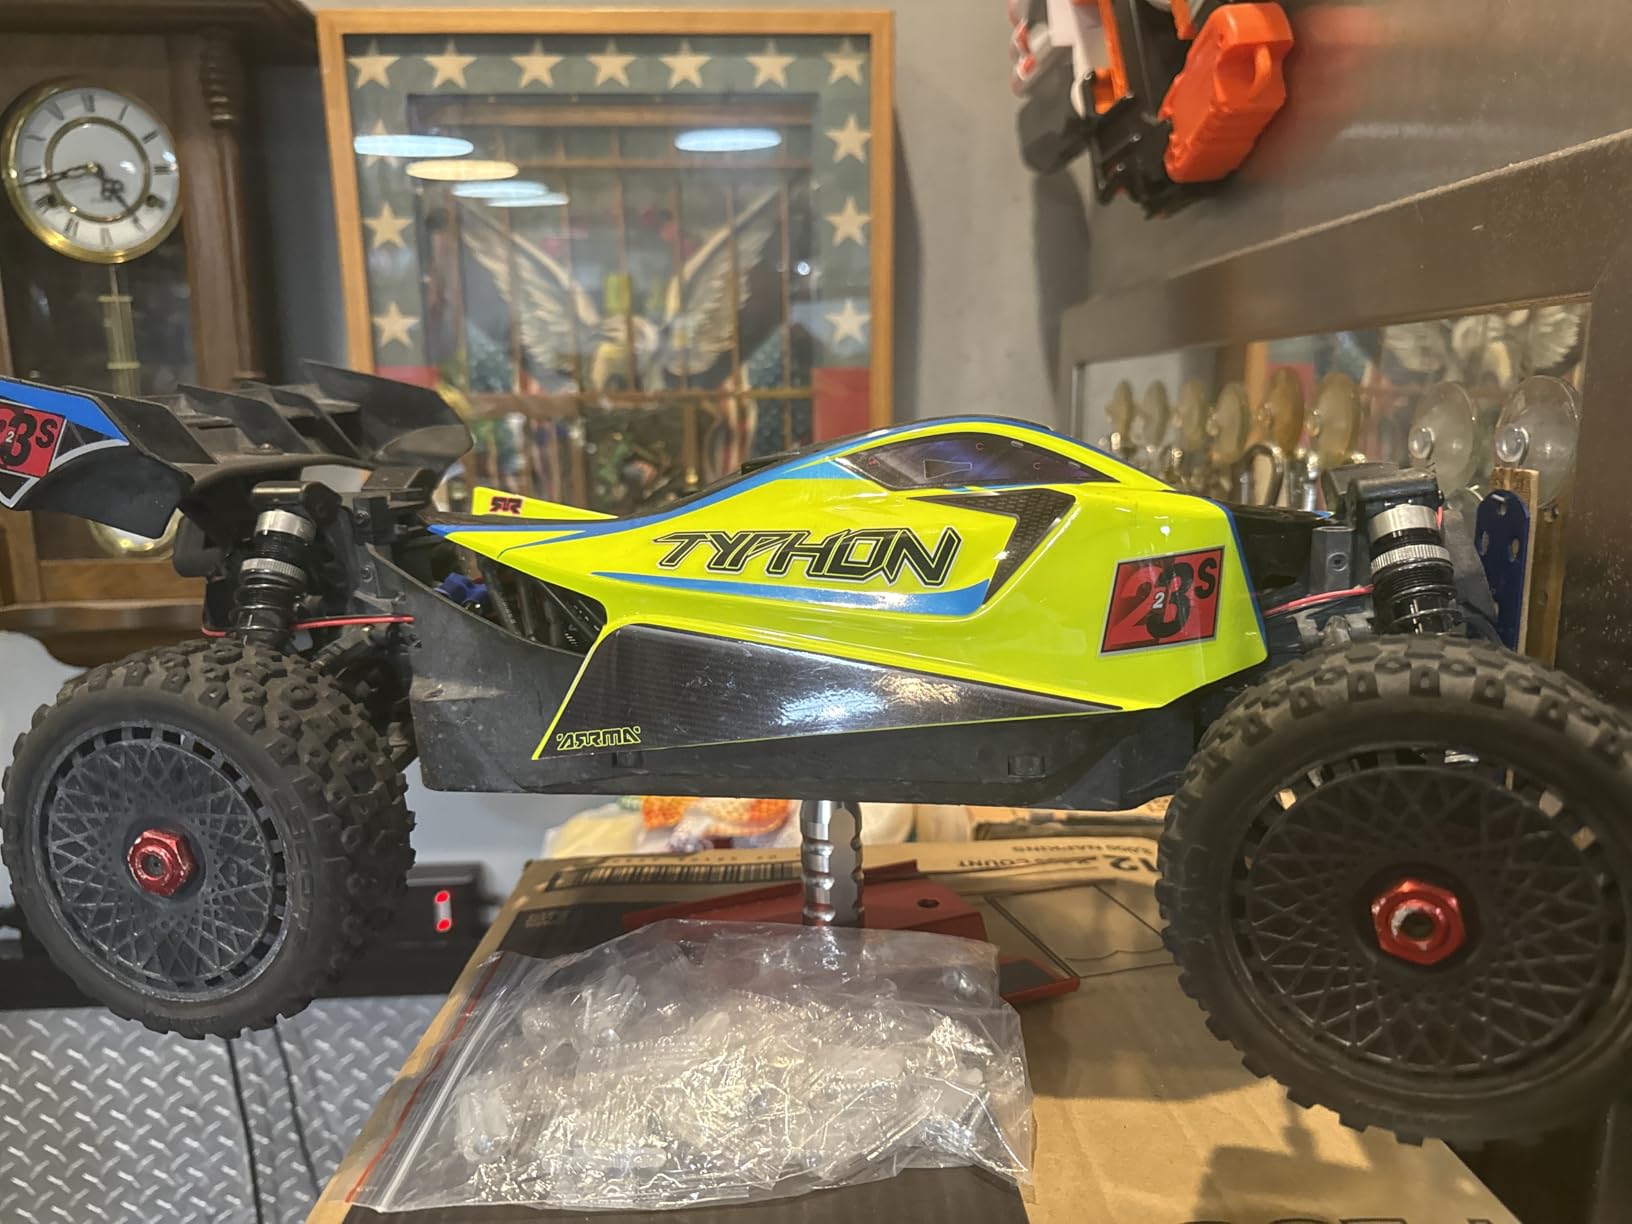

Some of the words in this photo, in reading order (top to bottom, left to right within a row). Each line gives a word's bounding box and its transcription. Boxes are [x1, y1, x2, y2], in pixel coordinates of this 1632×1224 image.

[652, 527, 963, 587] TYPHON
[556, 725, 642, 751] ARRMA
[959, 857, 1030, 868] COUNT
